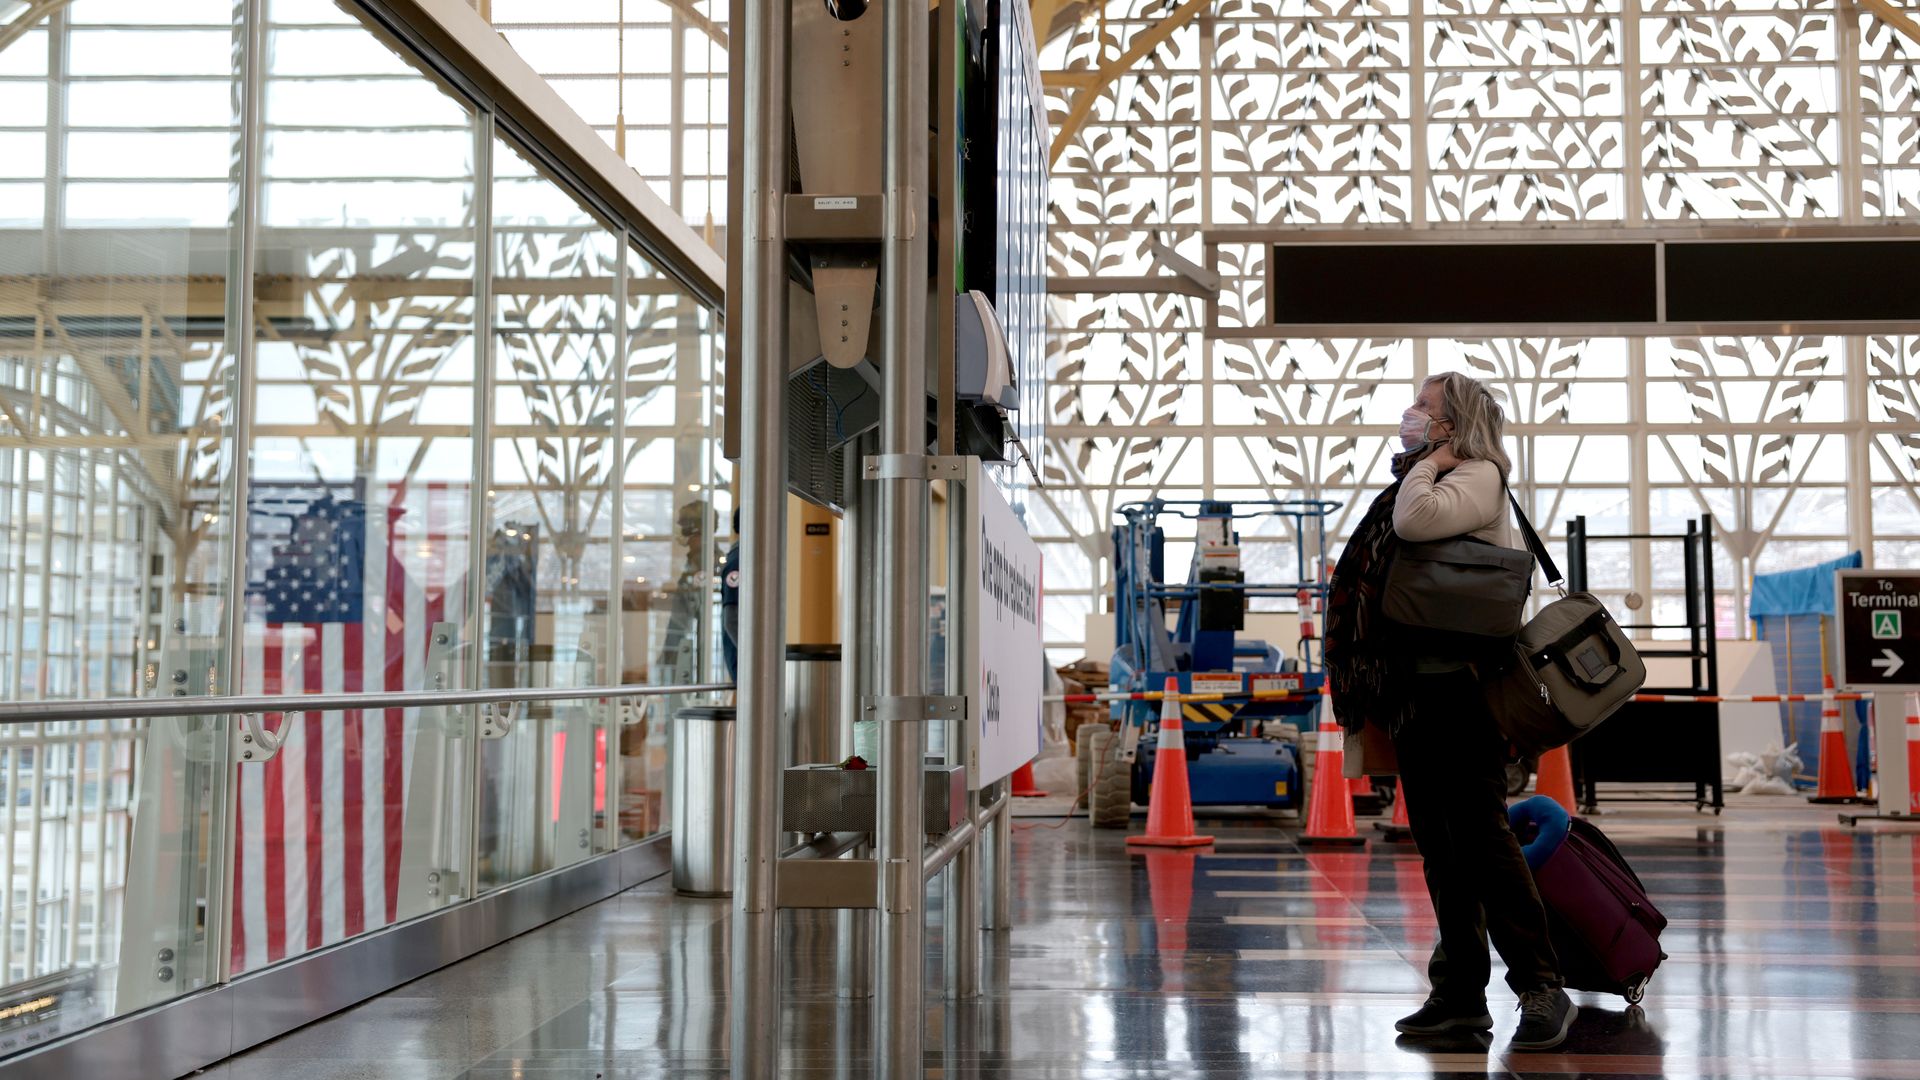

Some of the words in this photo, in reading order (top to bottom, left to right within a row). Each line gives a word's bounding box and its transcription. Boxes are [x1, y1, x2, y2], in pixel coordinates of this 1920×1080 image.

[982, 514, 992, 595] One
[1878, 580, 1893, 591] To
[1878, 614, 1897, 634] A
